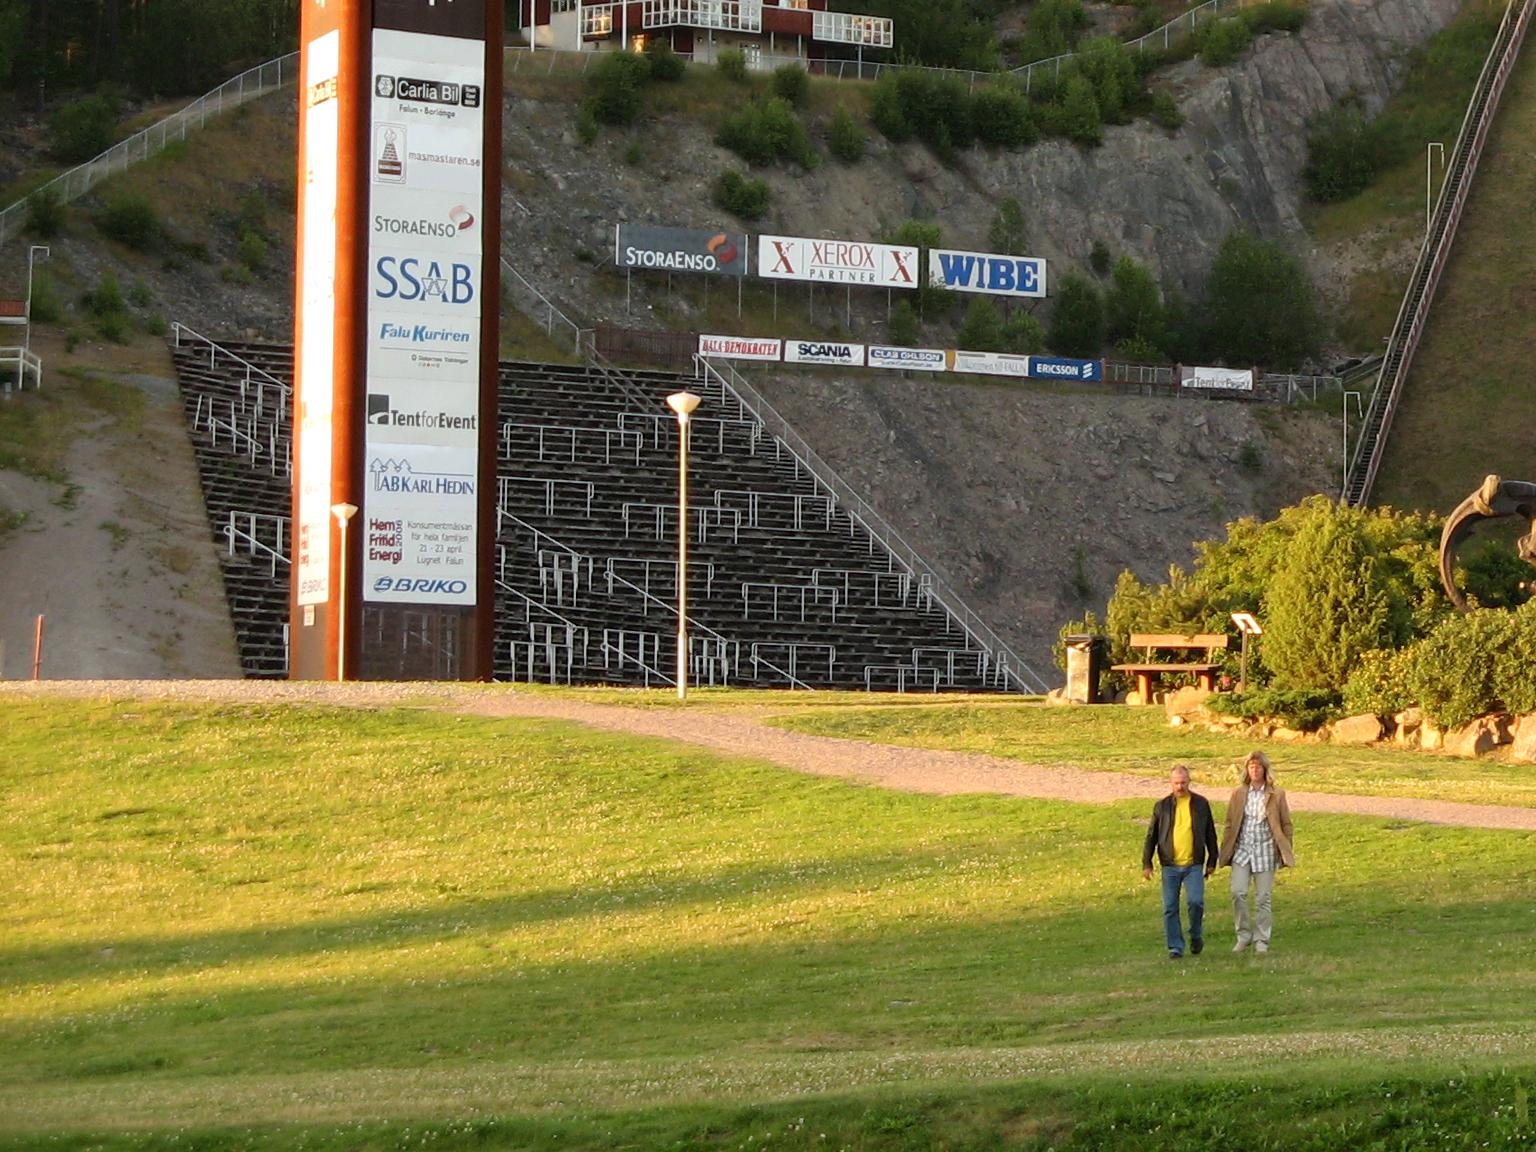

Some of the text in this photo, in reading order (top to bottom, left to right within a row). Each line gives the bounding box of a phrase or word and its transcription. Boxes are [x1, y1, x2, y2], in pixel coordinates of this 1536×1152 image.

[398, 80, 438, 100] Carlia
[441, 85, 459, 102] Bil
[811, 242, 876, 268] XEROX
[376, 255, 474, 304] SSAB
[809, 269, 876, 282] PARTNER
[938, 253, 1039, 292] WIBE
[380, 323, 470, 342] Falu Kuriren
[798, 343, 852, 358] SCANIA
[874, 349, 899, 358] CLAS
[1036, 363, 1079, 376] ERICSSON
[391, 410, 476, 429] TentforEvent
[435, 478, 475, 495] HEDIN
[369, 518, 395, 531] Hem
[369, 533, 395, 546] Fritid
[369, 548, 403, 564] Energi
[392, 578, 467, 594] BRIKO
